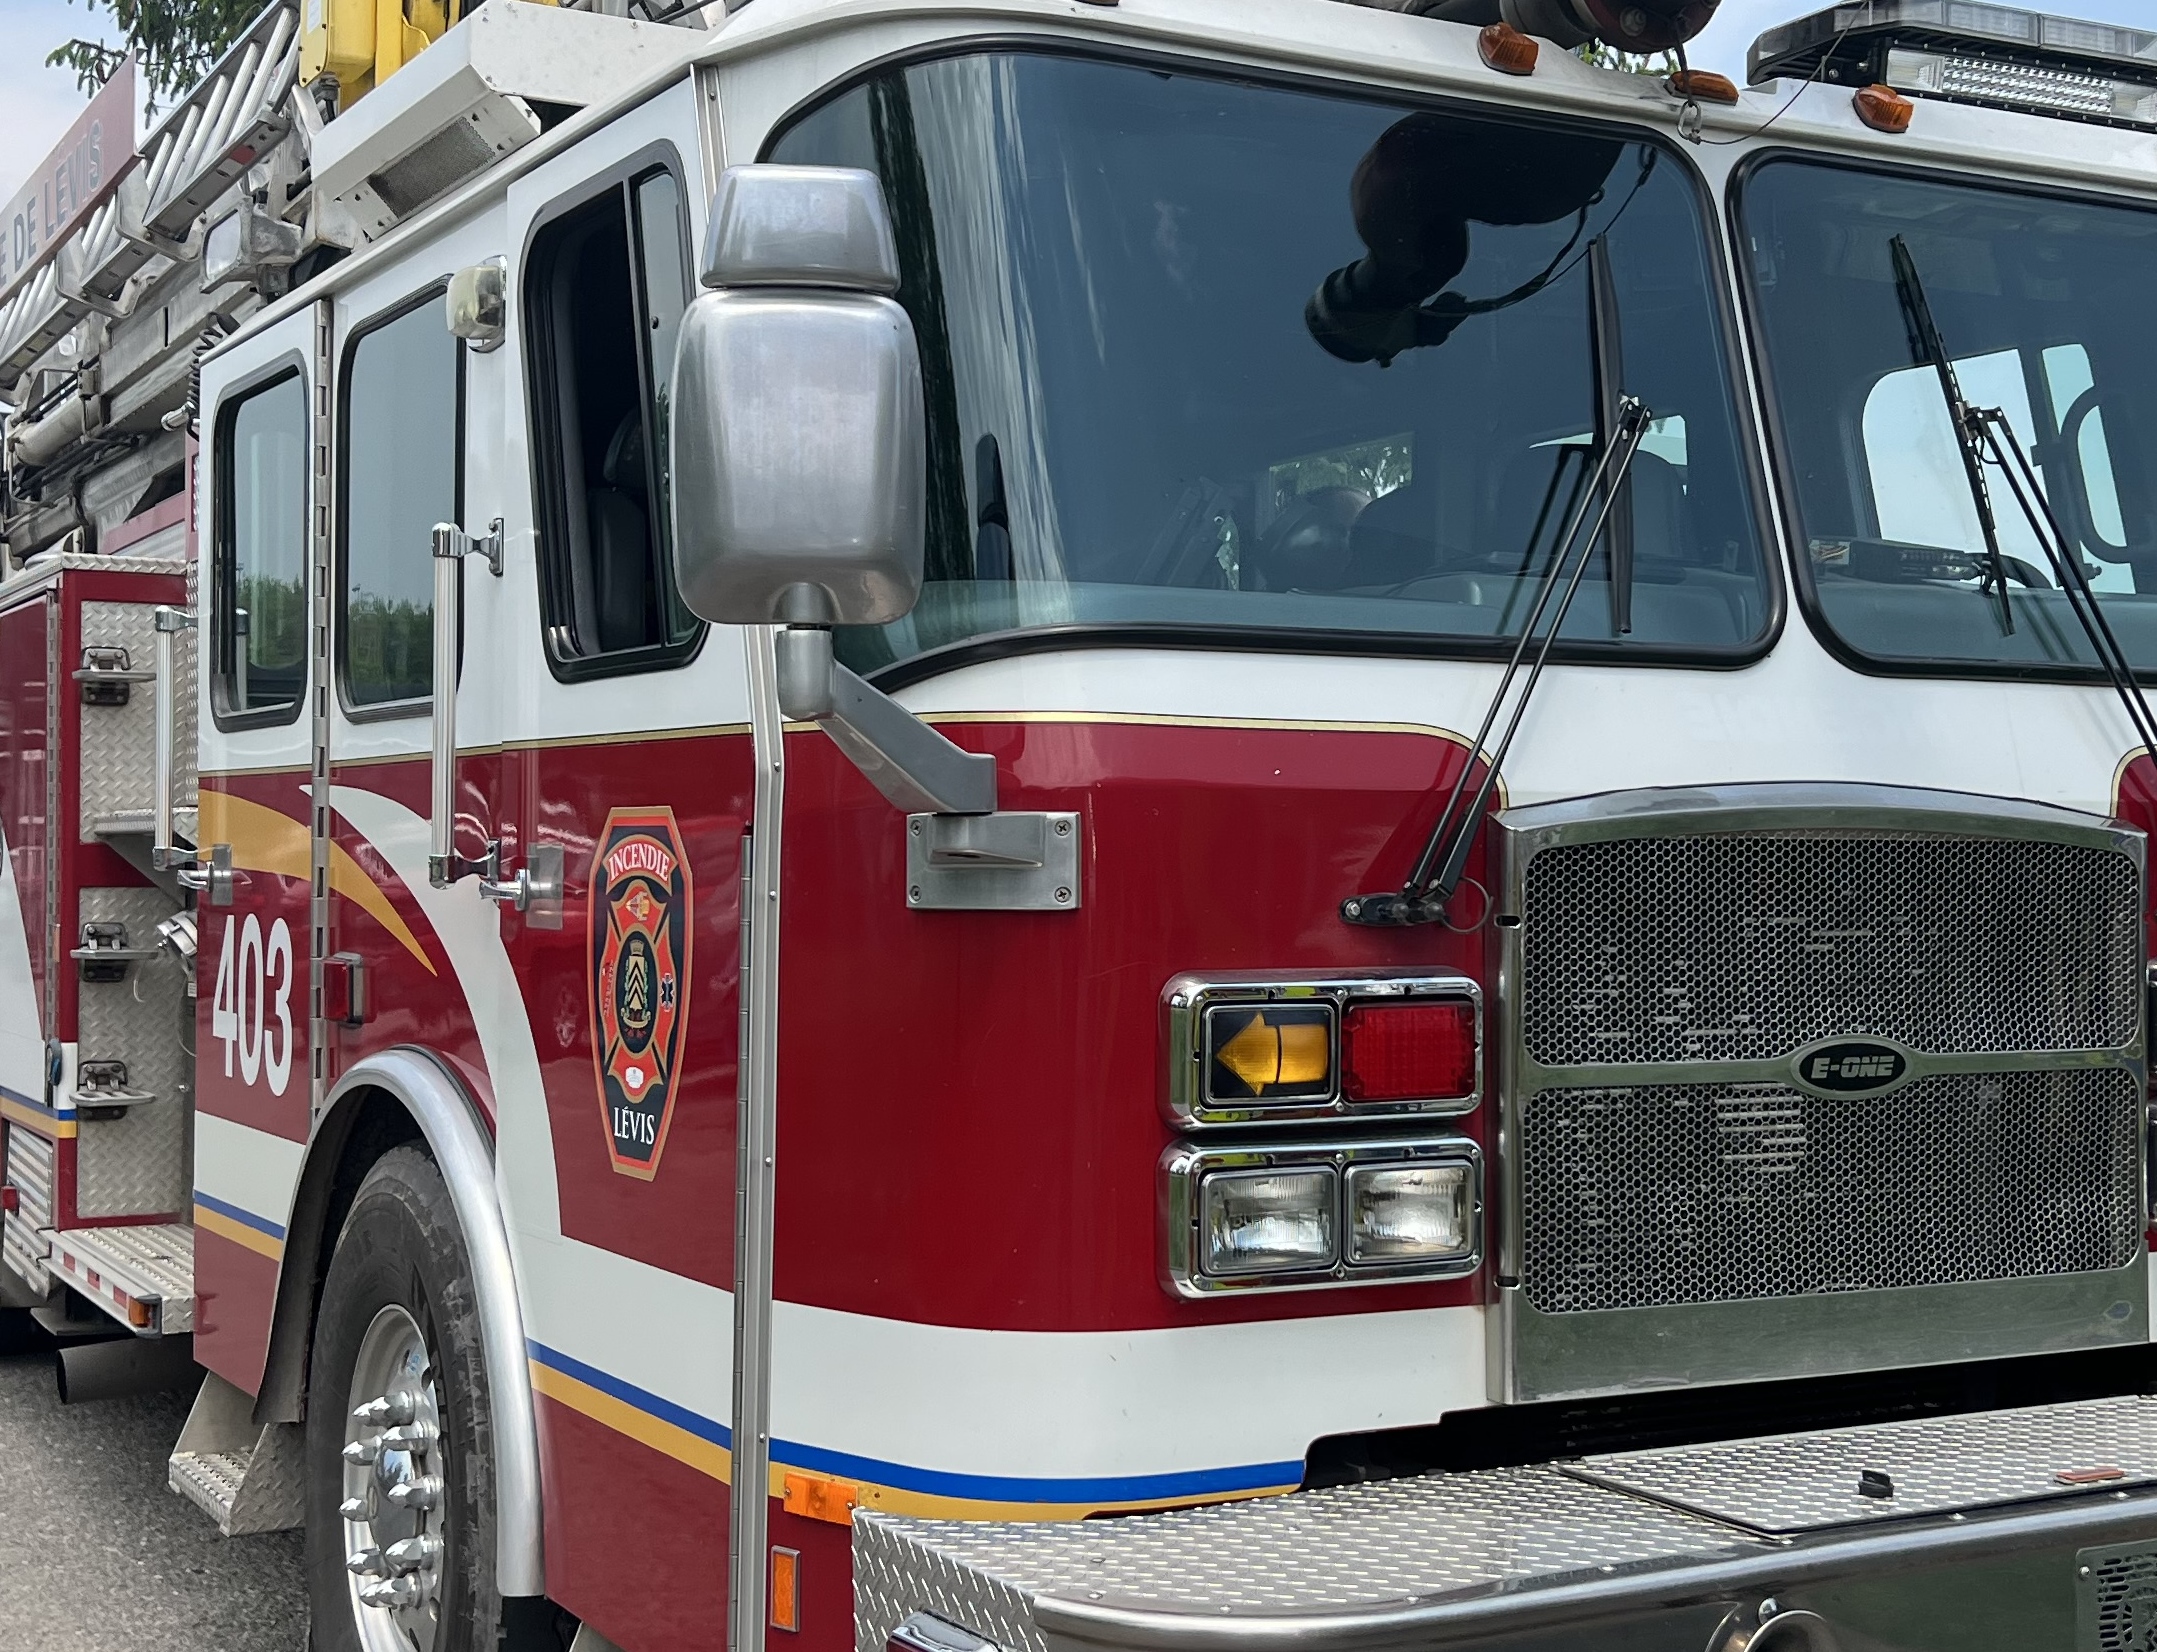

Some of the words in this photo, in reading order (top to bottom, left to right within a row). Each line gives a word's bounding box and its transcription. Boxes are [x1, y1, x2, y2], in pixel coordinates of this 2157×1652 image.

[14, 196, 37, 273] DE
[608, 842, 670, 882] INCENDIE
[212, 912, 293, 1097] 403
[1810, 1054, 1895, 1079] E-ONE
[613, 1105, 655, 1145] LÉVIS
